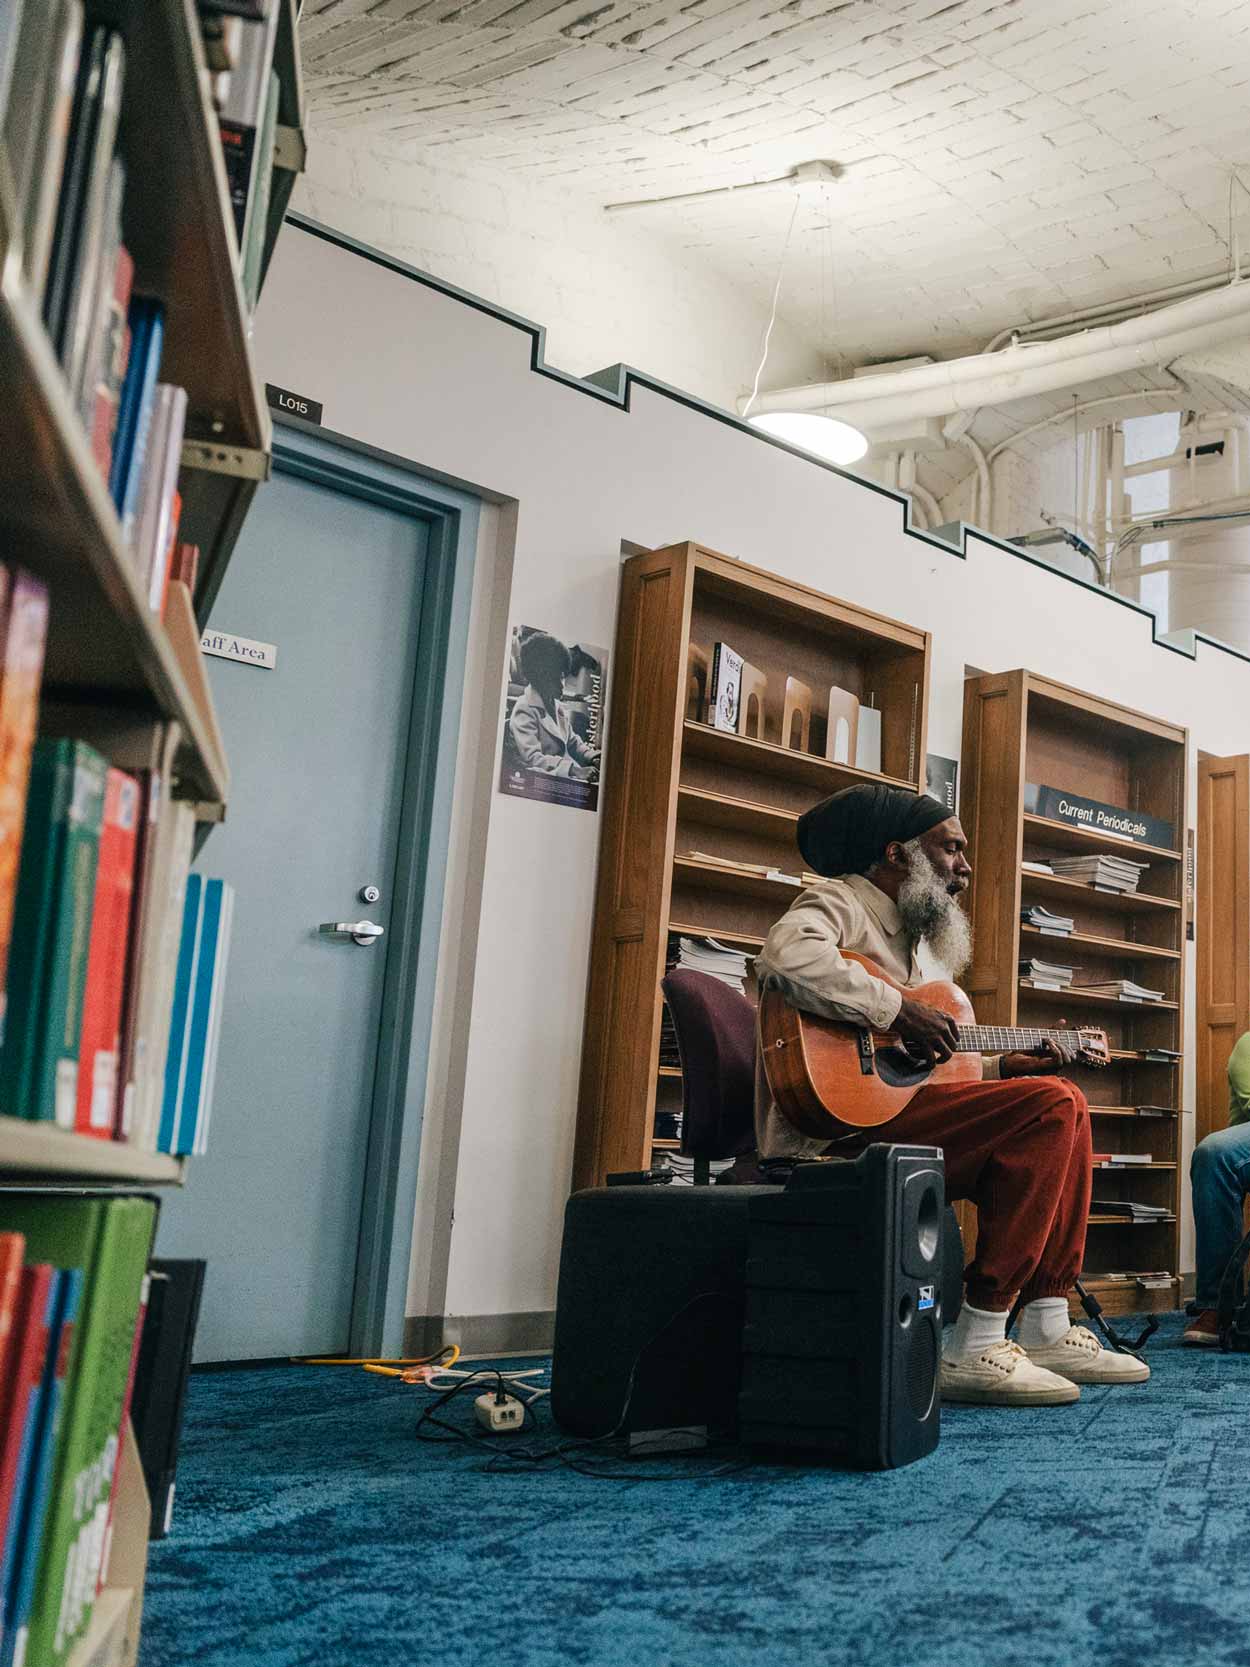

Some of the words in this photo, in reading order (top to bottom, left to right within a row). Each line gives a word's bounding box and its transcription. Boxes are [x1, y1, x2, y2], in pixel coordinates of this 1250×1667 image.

[202, 636, 227, 649] aff
[228, 641, 265, 660] Area
[585, 673, 601, 752] isterhood
[1058, 800, 1094, 822] Current
[1096, 811, 1147, 836] Periodicals
